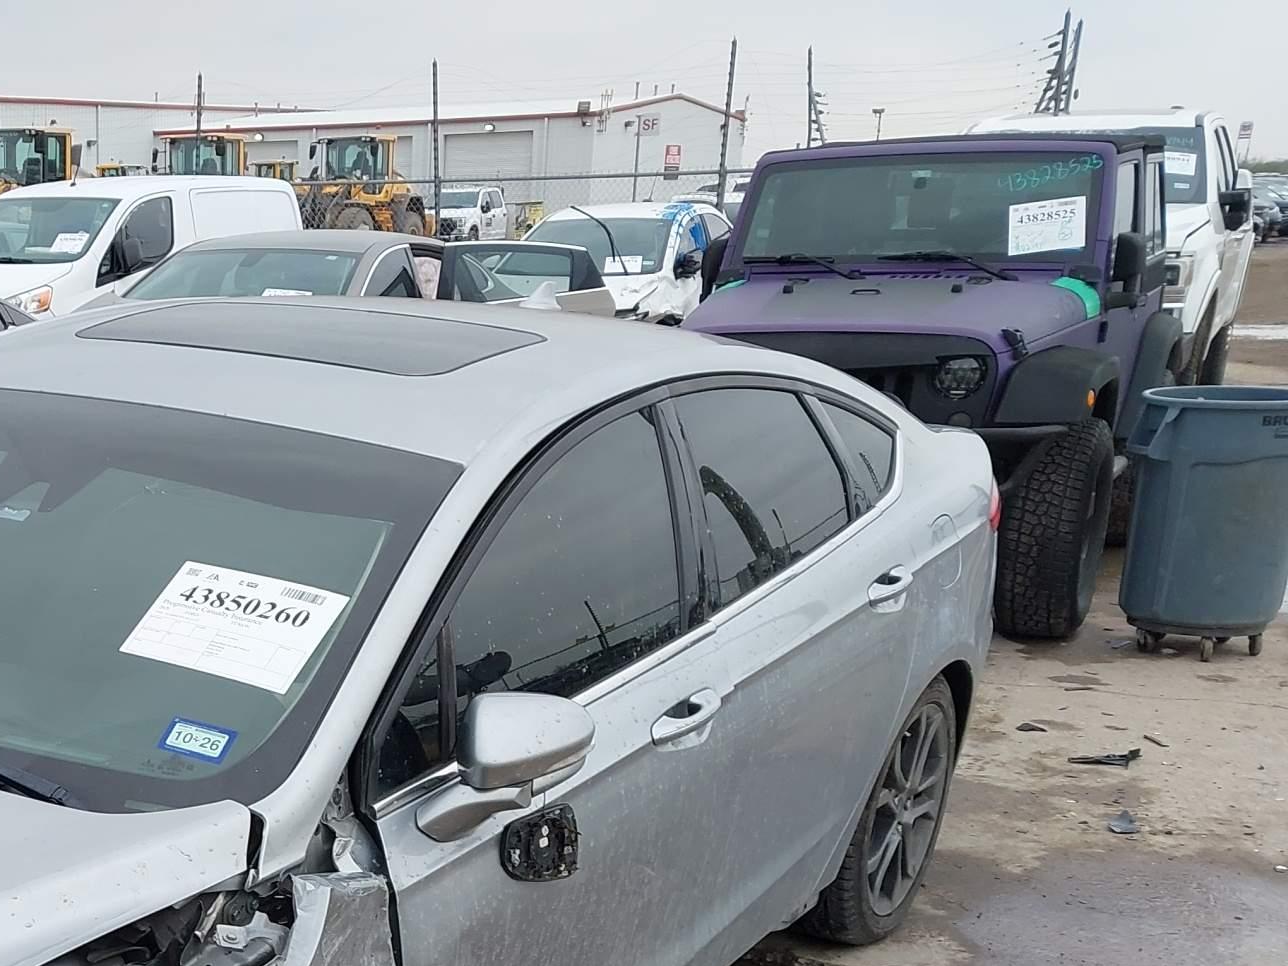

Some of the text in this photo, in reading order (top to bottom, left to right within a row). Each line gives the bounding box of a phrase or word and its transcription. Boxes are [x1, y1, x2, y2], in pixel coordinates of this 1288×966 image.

[642, 118, 659, 131] SF
[998, 154, 1104, 192] 43828525
[1017, 208, 1077, 225] 43828525
[179, 585, 312, 628] 43850260
